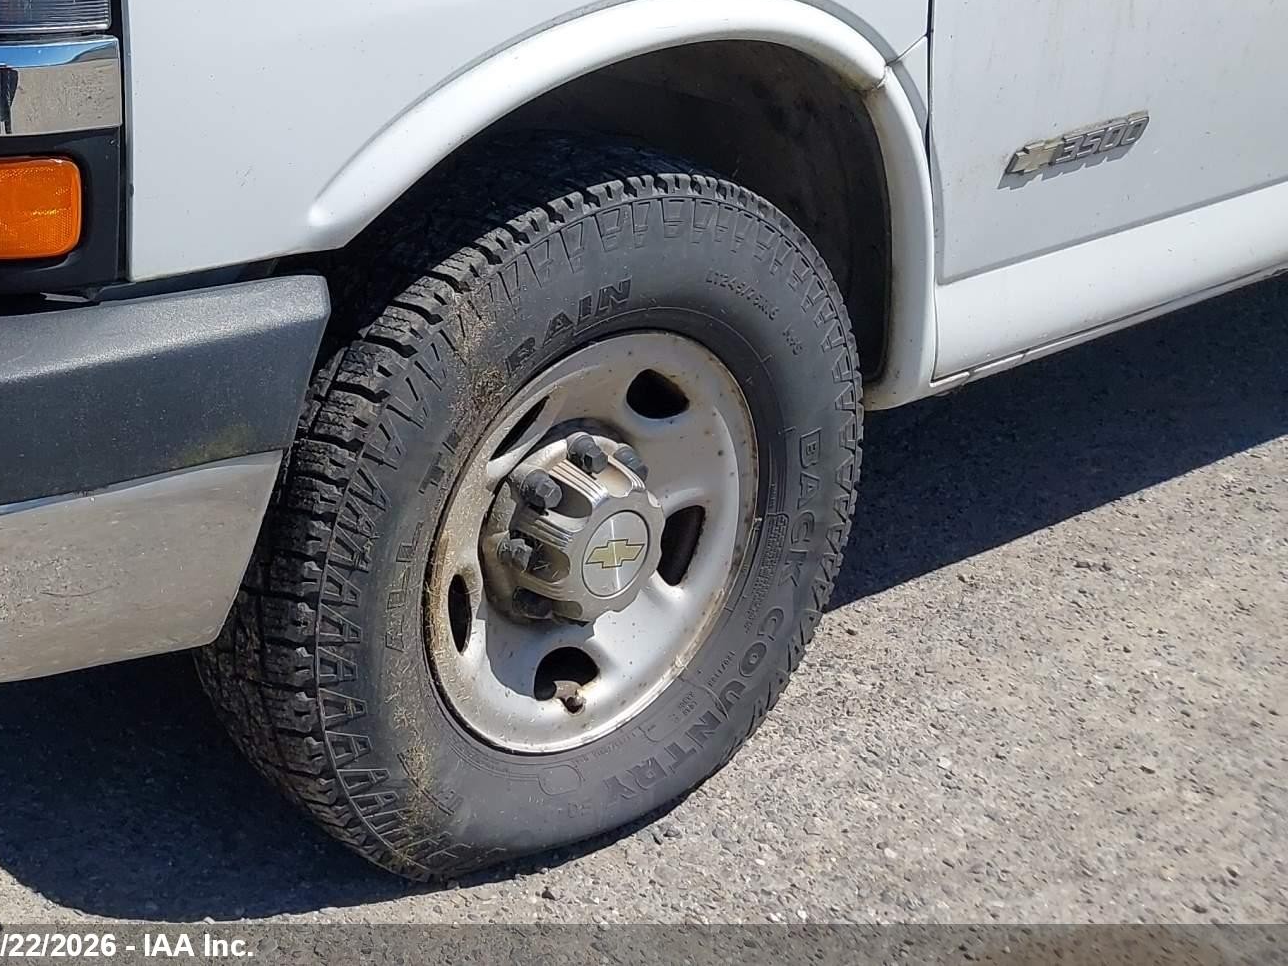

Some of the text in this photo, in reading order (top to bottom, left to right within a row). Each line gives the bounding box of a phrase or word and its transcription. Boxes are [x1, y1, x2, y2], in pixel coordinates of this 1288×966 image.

[1055, 115, 1150, 165] 3500
[778, 426, 824, 587] BACK
[603, 607, 786, 800] COUNTRY
